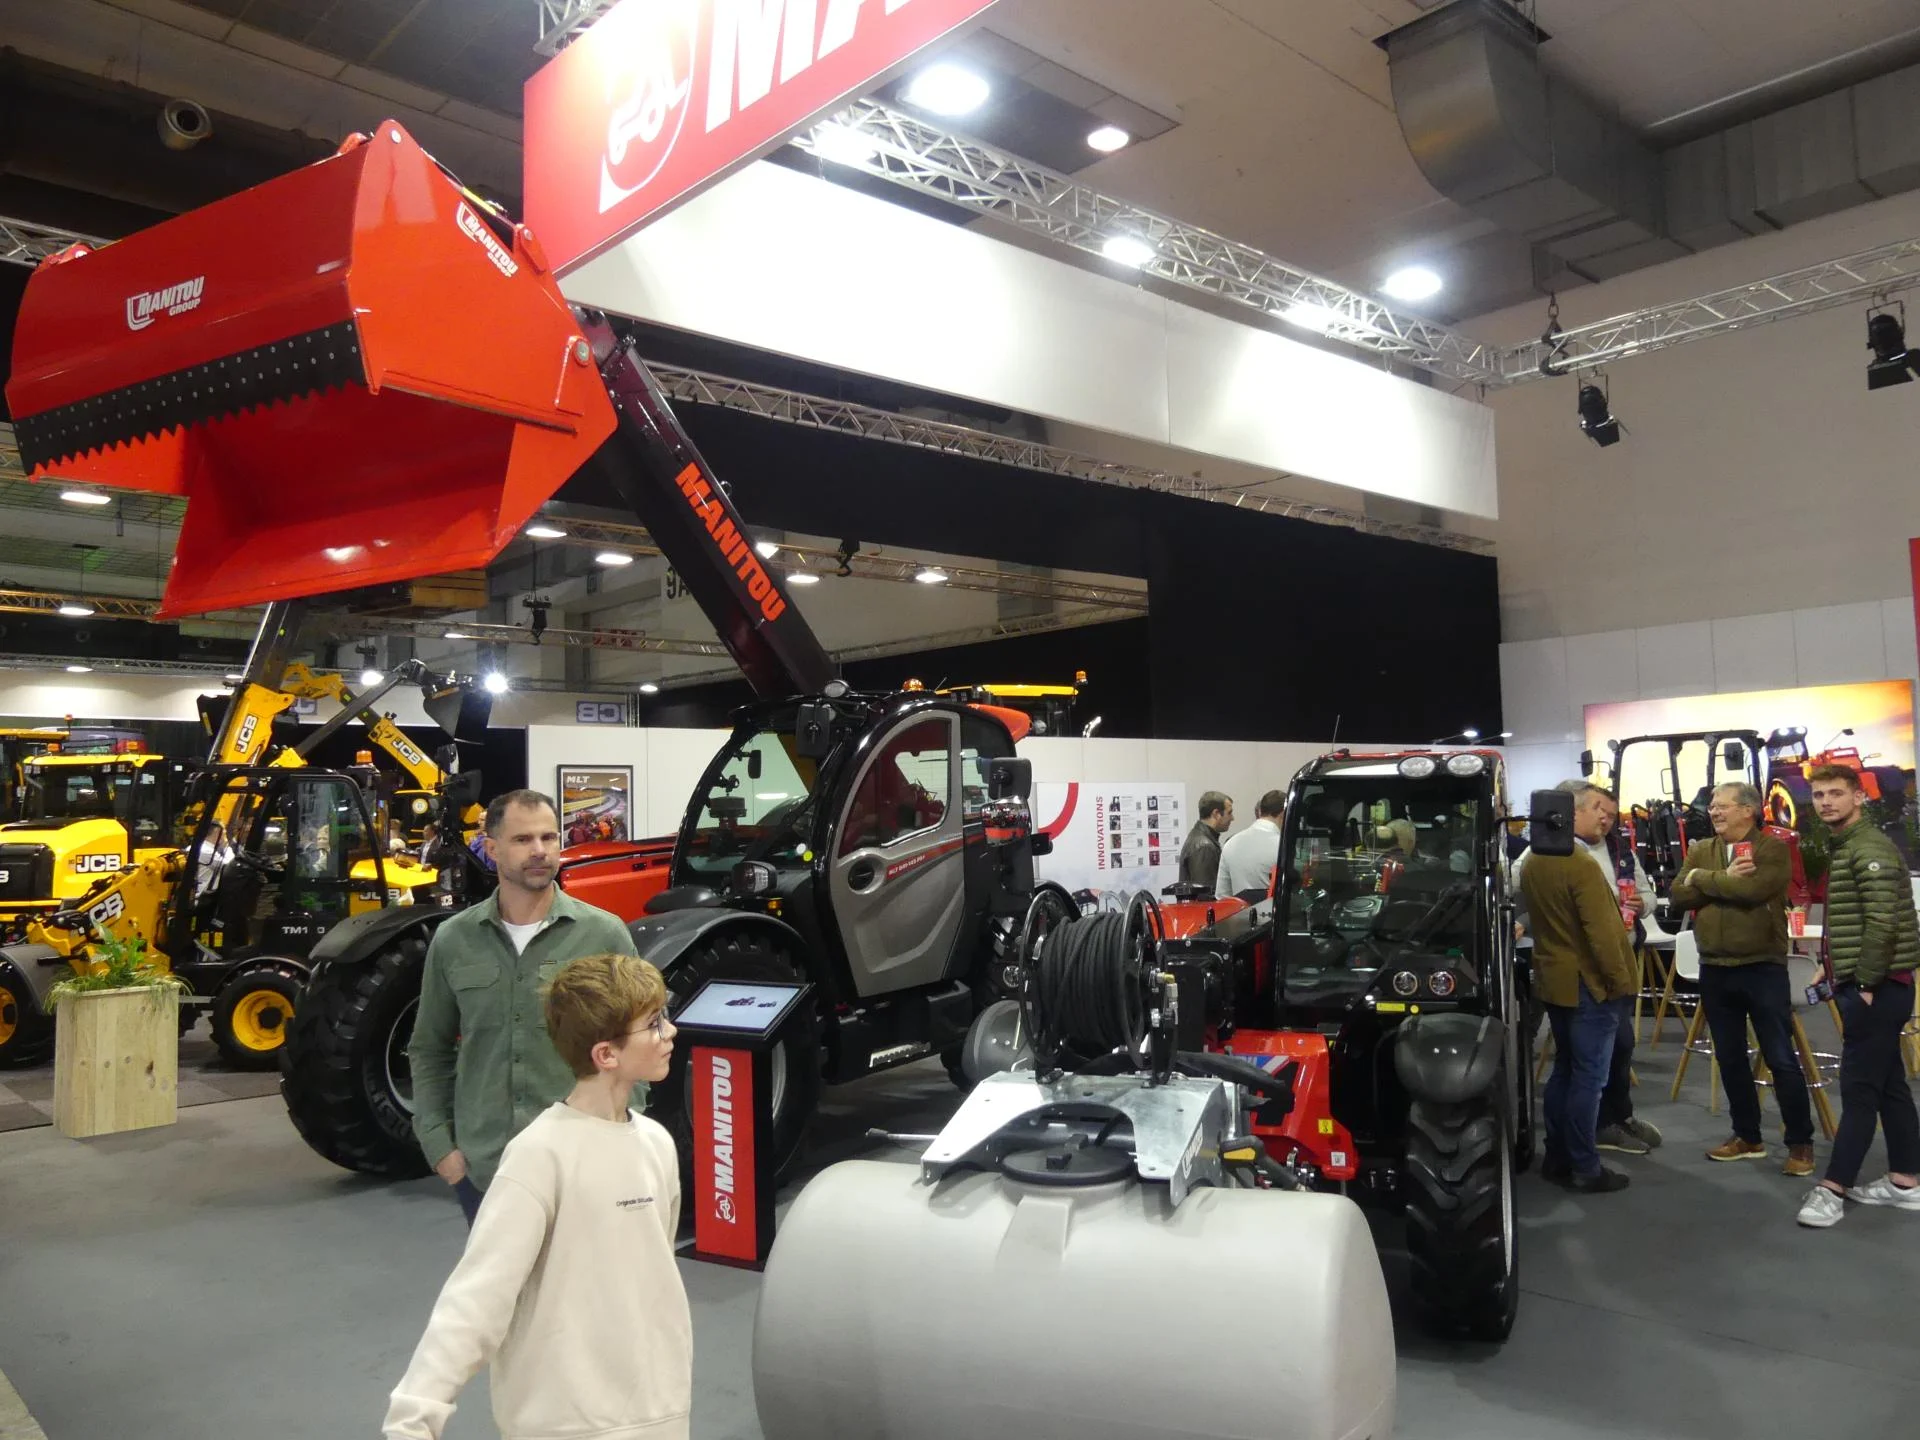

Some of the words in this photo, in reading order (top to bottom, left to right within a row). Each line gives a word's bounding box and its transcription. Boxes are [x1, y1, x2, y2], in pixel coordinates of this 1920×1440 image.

[464, 215, 519, 274] MANITOU
[137, 275, 205, 317] MANITOU
[168, 297, 201, 317] GROUP
[675, 462, 787, 622] MANITOU
[234, 715, 258, 753] JCB
[391, 740, 421, 765] JCB
[566, 775, 591, 783] MLT
[1095, 796, 1105, 870] INNOVATIONS
[76, 855, 121, 873] JCB
[711, 1056, 734, 1194] MANITOU
